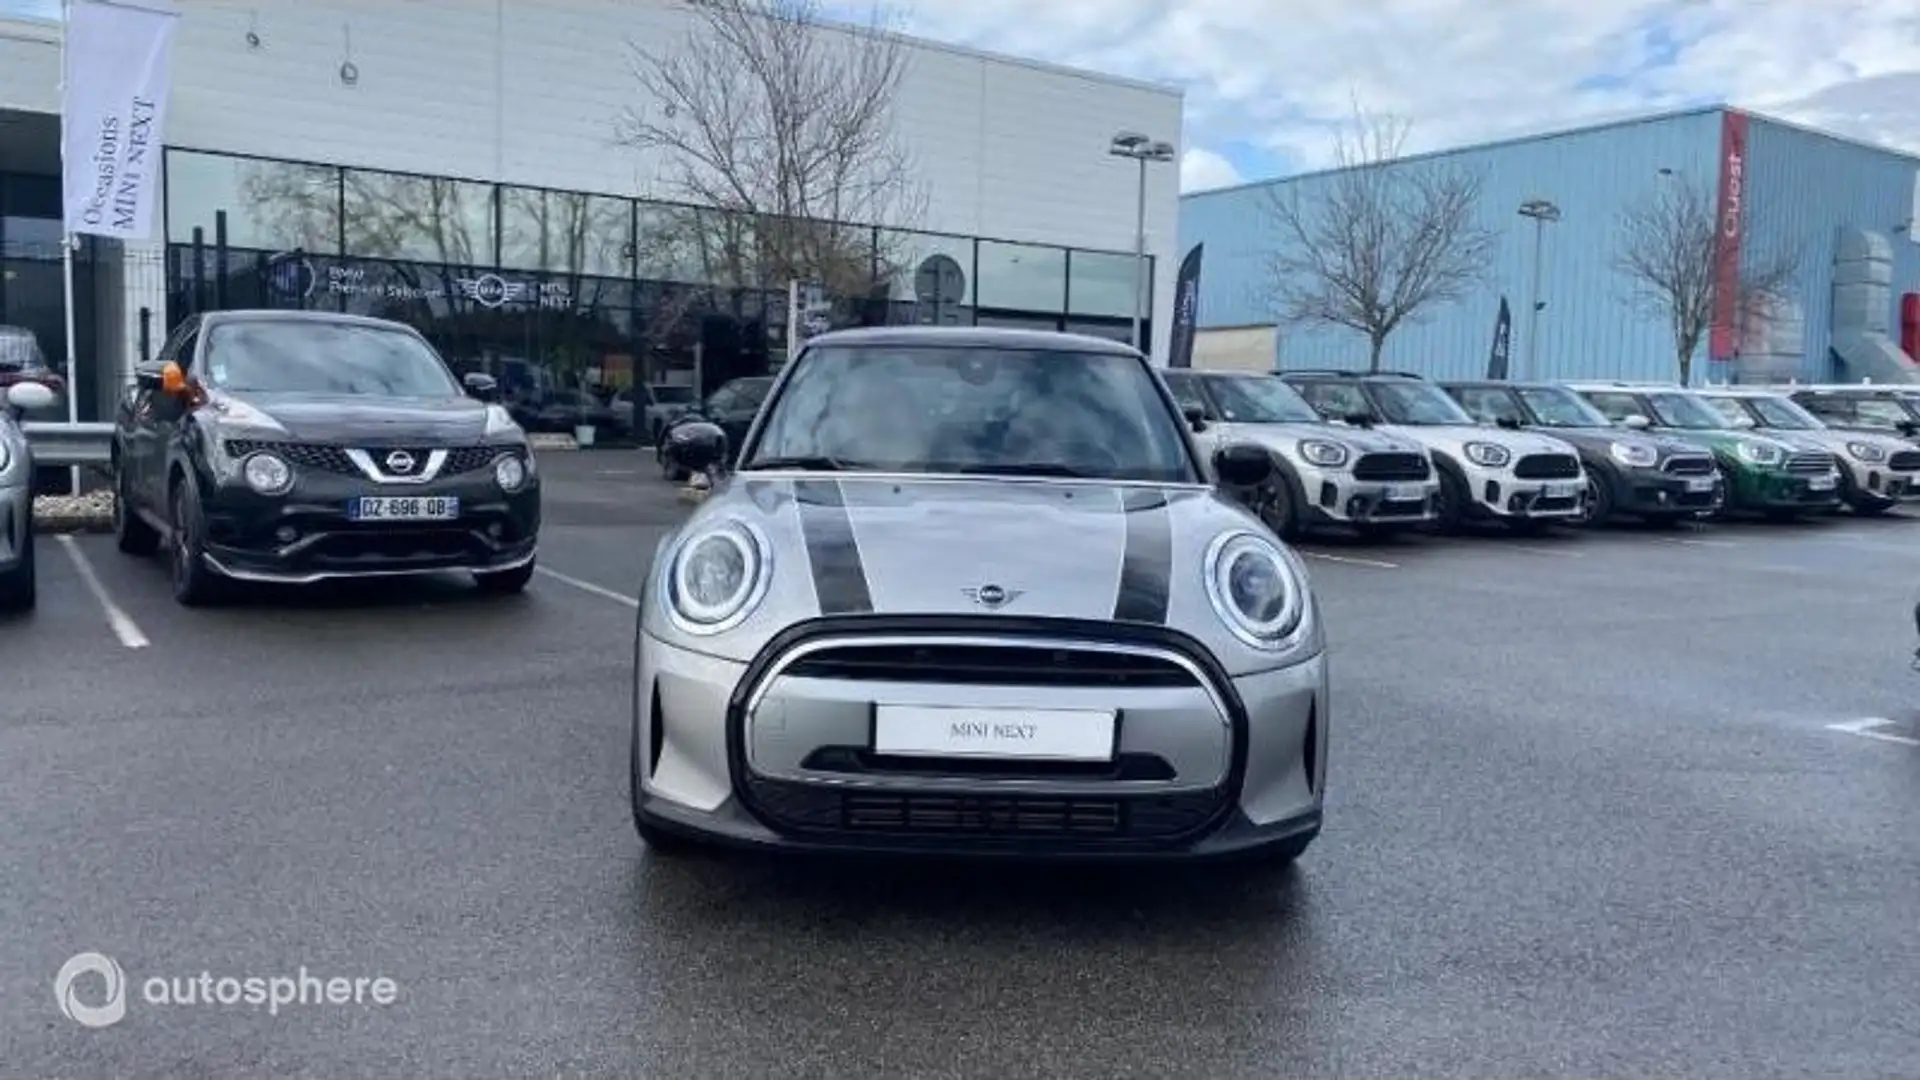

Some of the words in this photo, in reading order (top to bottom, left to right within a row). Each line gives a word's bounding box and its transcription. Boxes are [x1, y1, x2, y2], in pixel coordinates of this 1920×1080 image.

[83, 116, 118, 225] Occasions
[112, 172, 141, 231] MINI
[128, 95, 155, 164] NEXT
[951, 721, 988, 739] MINI
[993, 723, 1038, 739] NEXT
